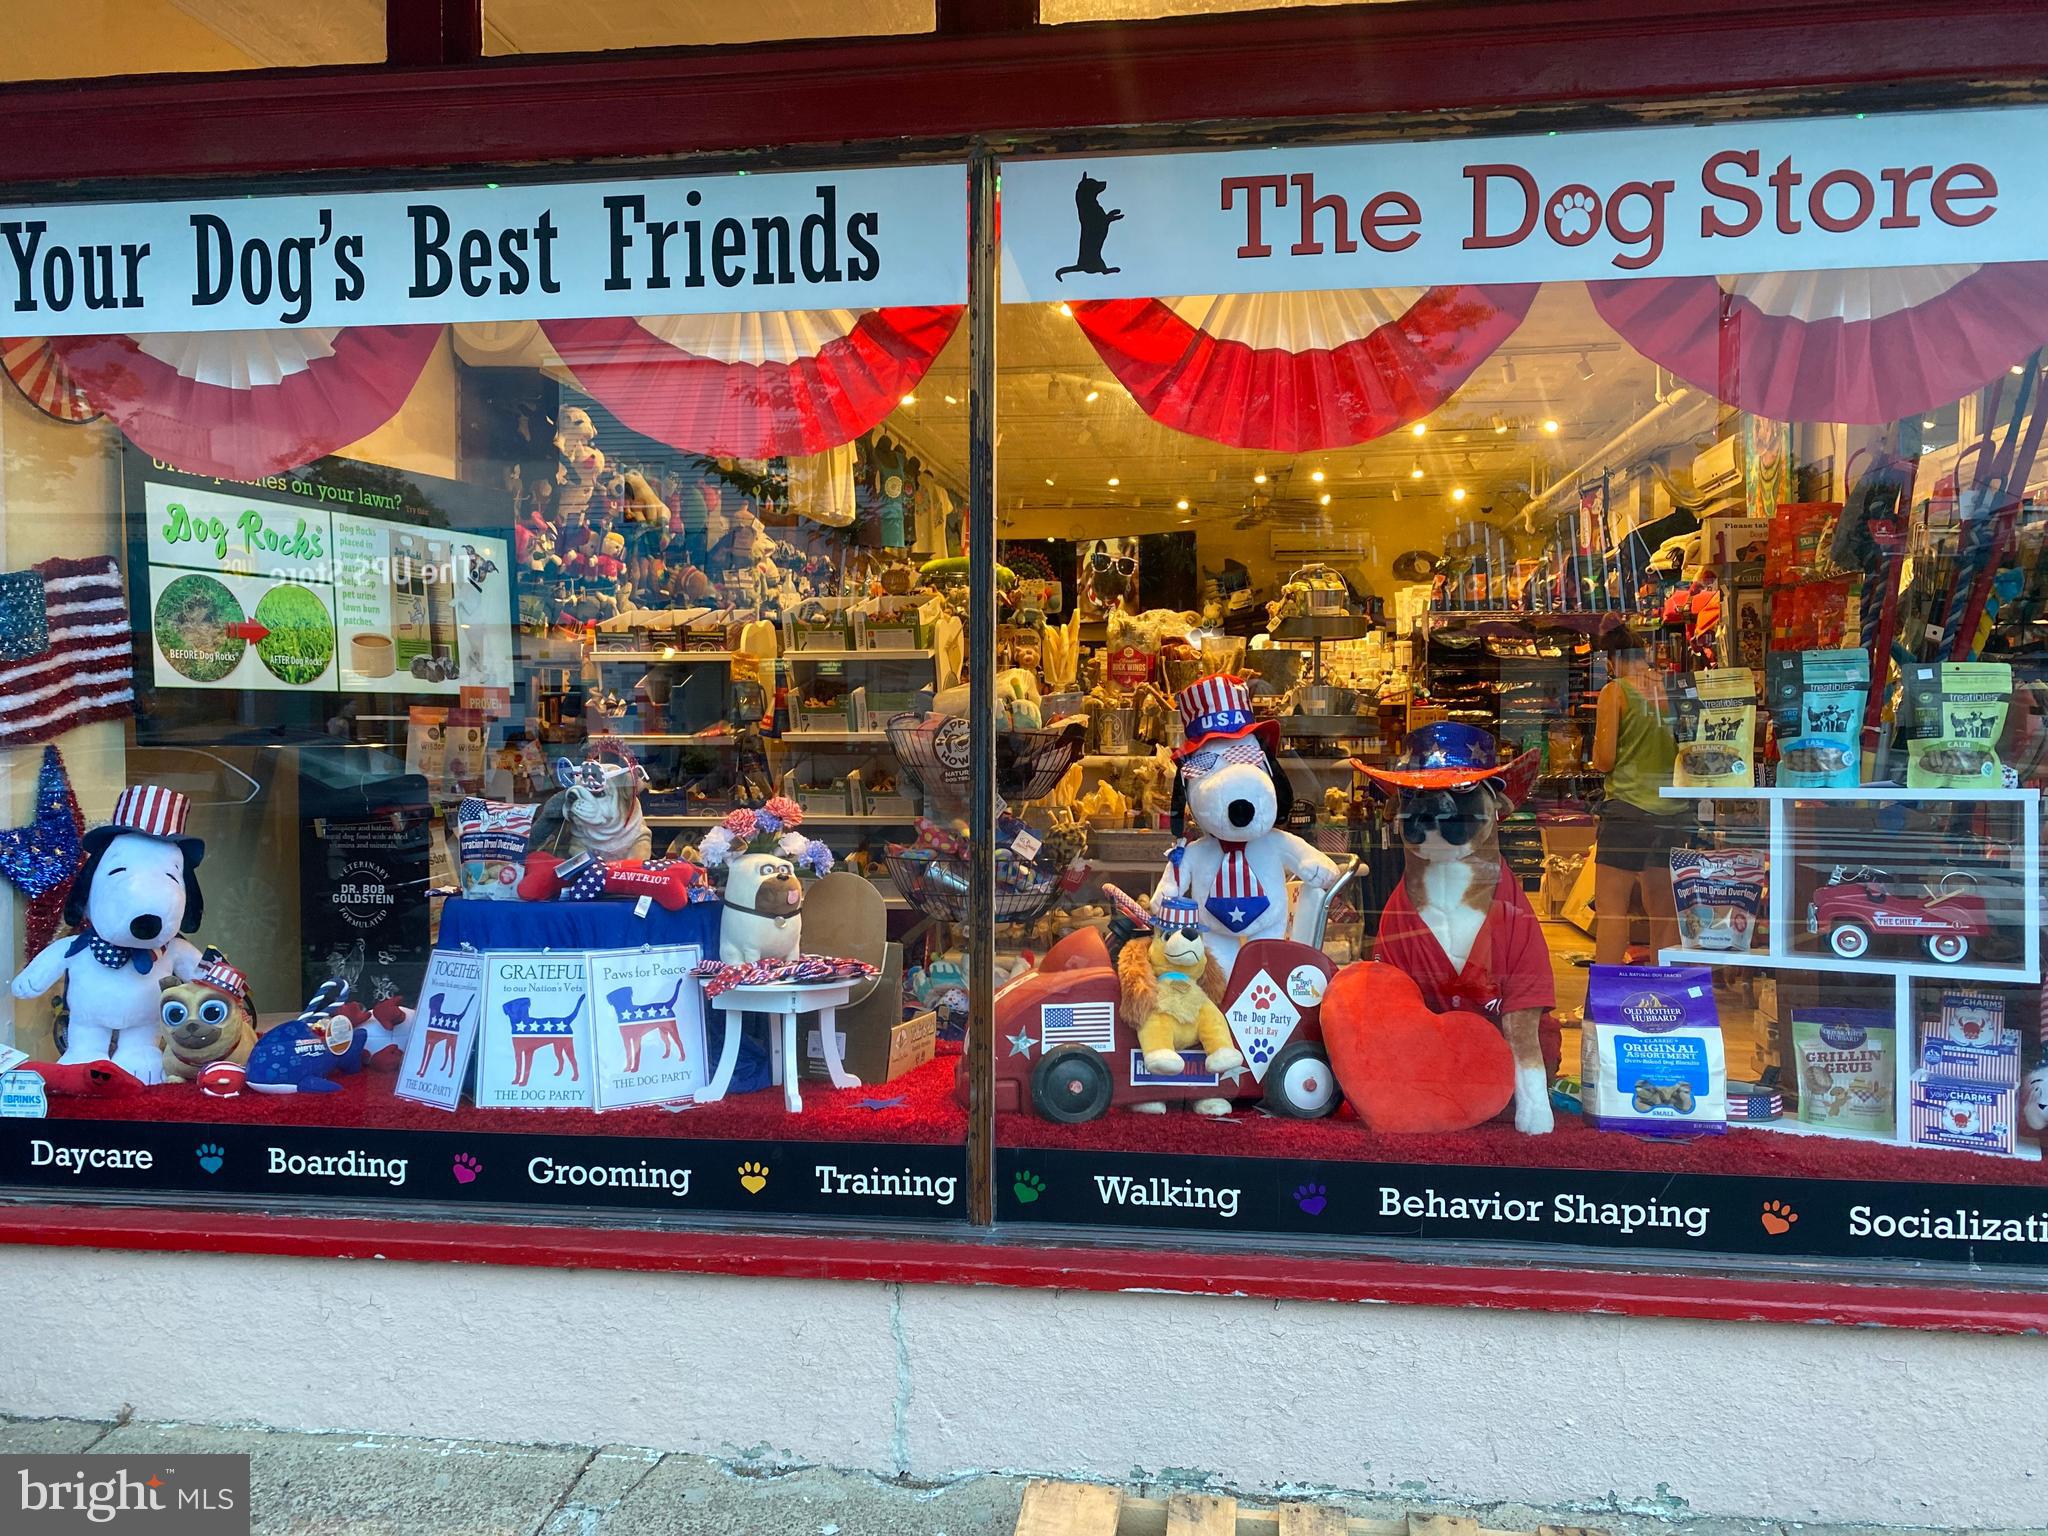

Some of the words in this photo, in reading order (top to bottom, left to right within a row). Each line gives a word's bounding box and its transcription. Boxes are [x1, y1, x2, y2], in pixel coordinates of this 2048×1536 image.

[1220, 173, 1422, 259] The
[1462, 163, 1675, 270] Dog
[1701, 149, 1998, 238] Store
[0, 221, 150, 312] Your
[190, 208, 365, 324] Dog's
[407, 205, 560, 298] Best
[603, 185, 880, 290] Friends
[292, 480, 313, 496] on
[318, 484, 354, 502] your
[358, 488, 402, 510] lawn?
[163, 503, 229, 560] Dog
[339, 523, 354, 536] Dog
[356, 526, 376, 537] Rocks
[340, 537, 364, 548] placed
[366, 541, 373, 549] in
[340, 551, 357, 560] your
[343, 591, 355, 600] pet
[357, 592, 376, 601] urine
[343, 602, 361, 612] lawn
[363, 604, 380, 614] burn
[170, 649, 197, 660] BEFORE
[199, 649, 214, 662] Dog
[270, 655, 290, 664] AFTER
[291, 656, 303, 666] Dog
[1128, 663, 1146, 671] WINGS
[1811, 683, 1855, 692] treatibles
[1703, 698, 1744, 708] treatibles
[1950, 693, 1998, 702] treatibles
[1692, 744, 1724, 752] BALANCE
[342, 833, 354, 841] dog
[356, 832, 371, 840] food
[372, 832, 386, 840] with
[388, 832, 408, 840] added
[610, 870, 670, 885] PAWTRIOT
[341, 884, 360, 894] DR.
[362, 884, 385, 894] BOB
[1677, 883, 1707, 898] Operation
[1708, 885, 1727, 895] Drool
[1728, 886, 1758, 902] Overload
[332, 894, 394, 904] GOLDSTEIN
[339, 906, 388, 928] FORMULATED
[1878, 918, 1893, 926] THE
[1894, 918, 1917, 926] CHIEF
[434, 960, 481, 979] TOGETHER
[500, 964, 585, 980] GRATEFUL
[603, 968, 634, 980] Paws
[635, 965, 650, 977] for
[652, 963, 686, 976] Peace
[503, 984, 512, 992] to
[528, 982, 562, 992] Nation's
[564, 982, 583, 992] Vets
[1233, 1011, 1247, 1022] The
[1252, 1012, 1266, 1025] Dog
[1270, 1013, 1291, 1026] Party
[1245, 1026, 1251, 1034] of
[1254, 1026, 1264, 1034] Del
[1267, 1027, 1278, 1037] Ray
[1623, 1043, 1698, 1054] ORIGINAL
[1943, 1045, 1999, 1056] MICROWAVABLE
[1626, 1051, 1696, 1060] ASSORTMENT
[1806, 1050, 1886, 1063] GRILLIN'
[1824, 1062, 1873, 1074] GRUB
[612, 1079, 635, 1089] THE
[637, 1075, 658, 1086] DOG
[660, 1071, 692, 1084] PARTY
[405, 1078, 417, 1090] THE
[419, 1081, 432, 1093] DOG
[432, 1084, 453, 1098] PARTY
[7, 1094, 41, 1104] BRINKS
[494, 1090, 518, 1100] THE
[521, 1090, 546, 1100] DOG
[549, 1090, 585, 1100] PARTY
[30, 1139, 153, 1174] Daycare
[267, 1147, 408, 1186] Boarding
[527, 1156, 692, 1197] Grooming
[815, 1165, 957, 1204] Training
[1094, 1175, 1241, 1217] Walking
[1378, 1187, 1544, 1221] Behavior
[1554, 1193, 1710, 1237] Shaping
[1849, 1206, 2048, 1242] Socializati
